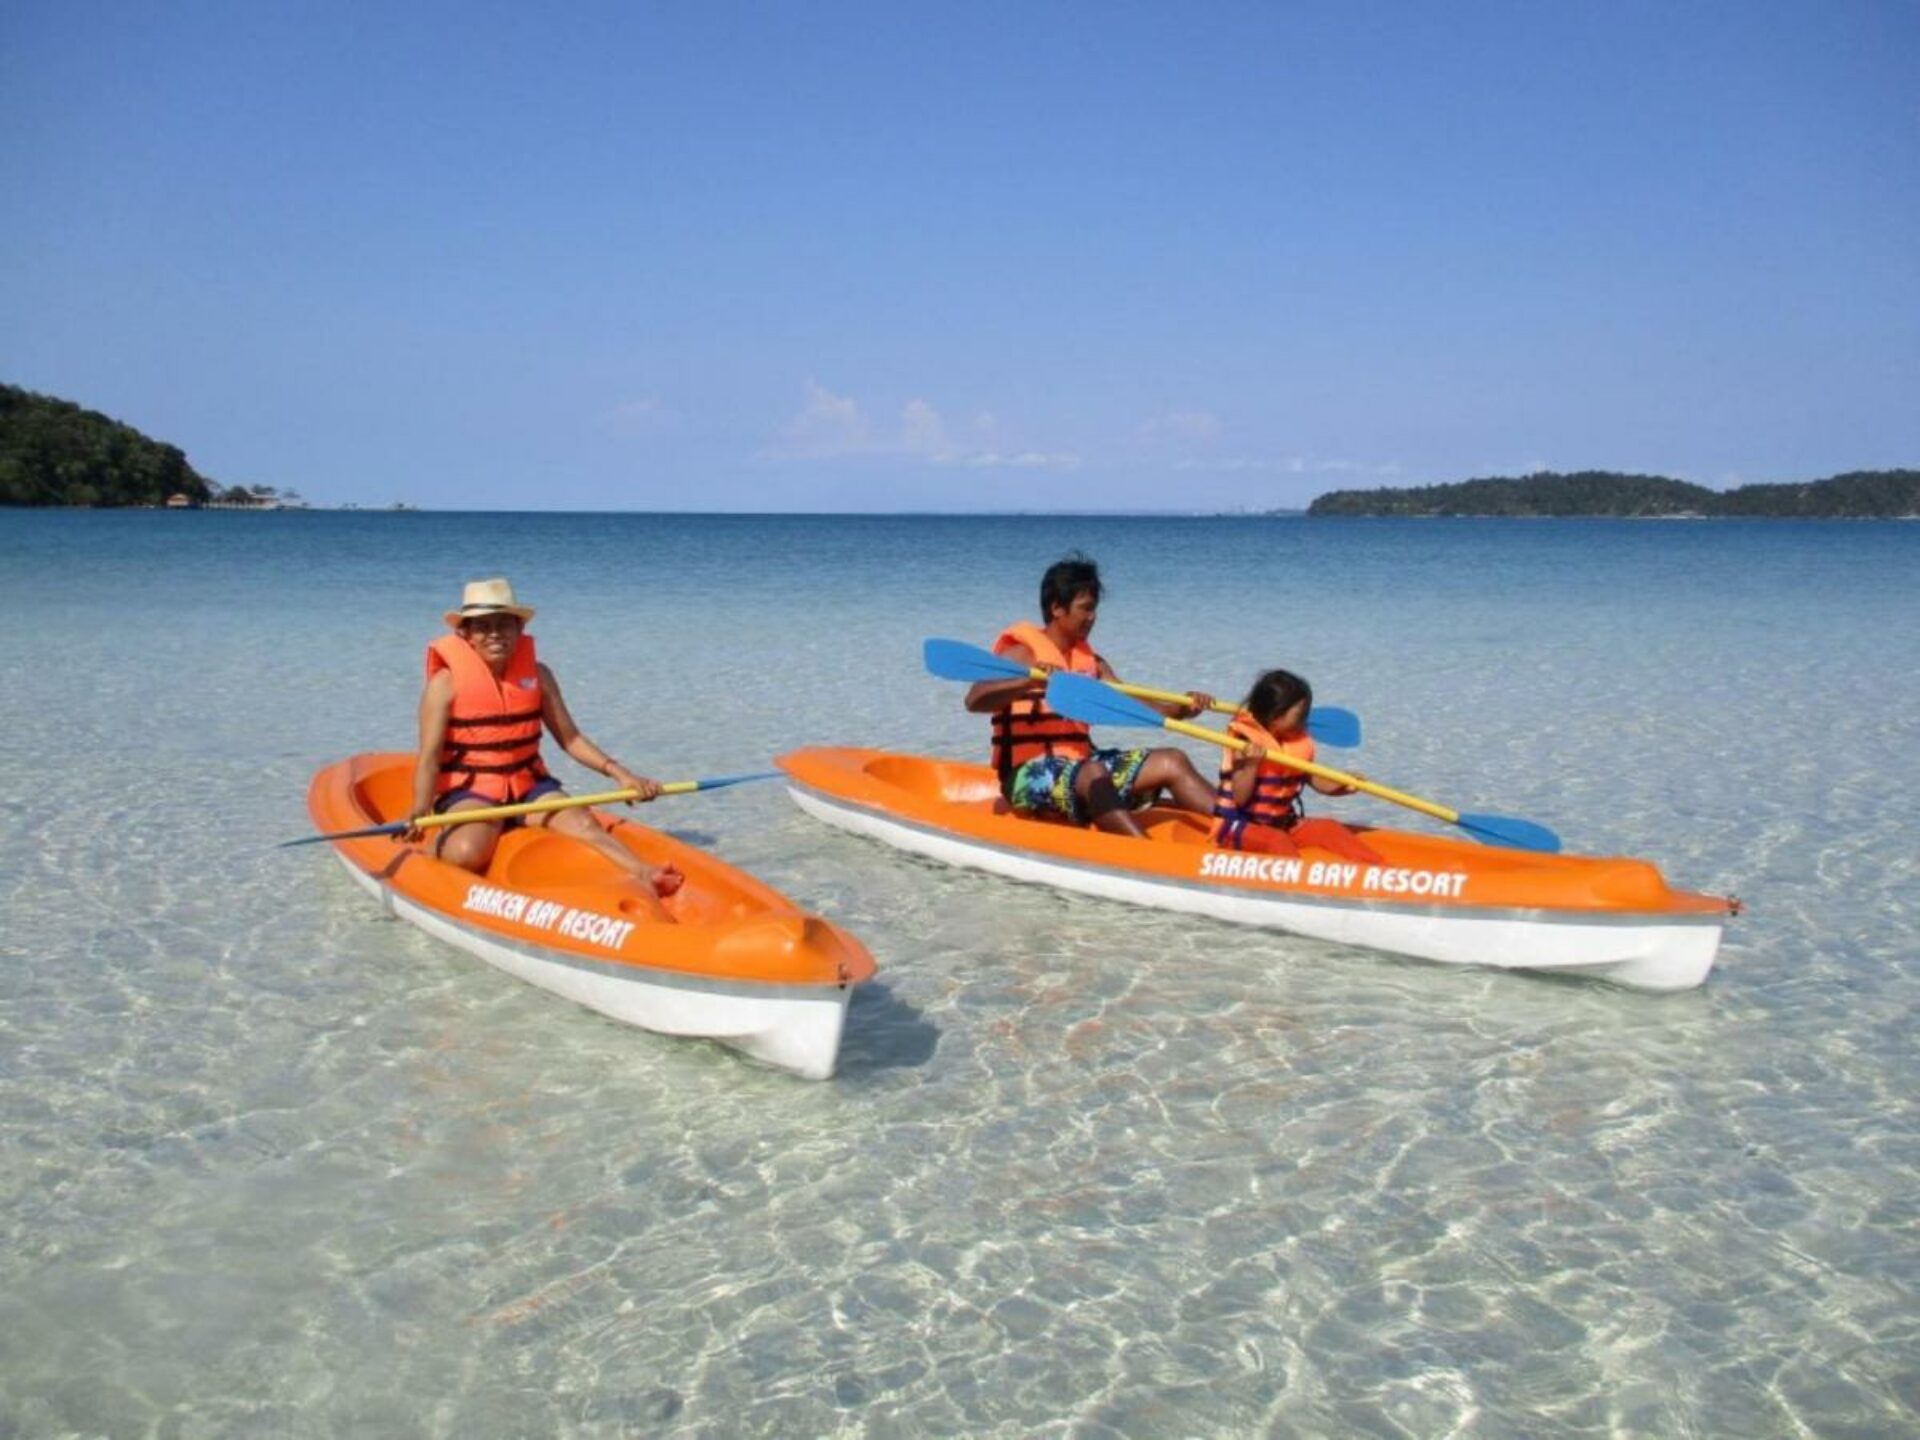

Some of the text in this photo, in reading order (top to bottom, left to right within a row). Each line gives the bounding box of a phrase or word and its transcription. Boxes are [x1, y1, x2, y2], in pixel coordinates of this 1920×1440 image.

[1200, 854, 1467, 897] SARACEN BAY RESORT
[462, 885, 636, 950] SARACEN BAY RESORT
